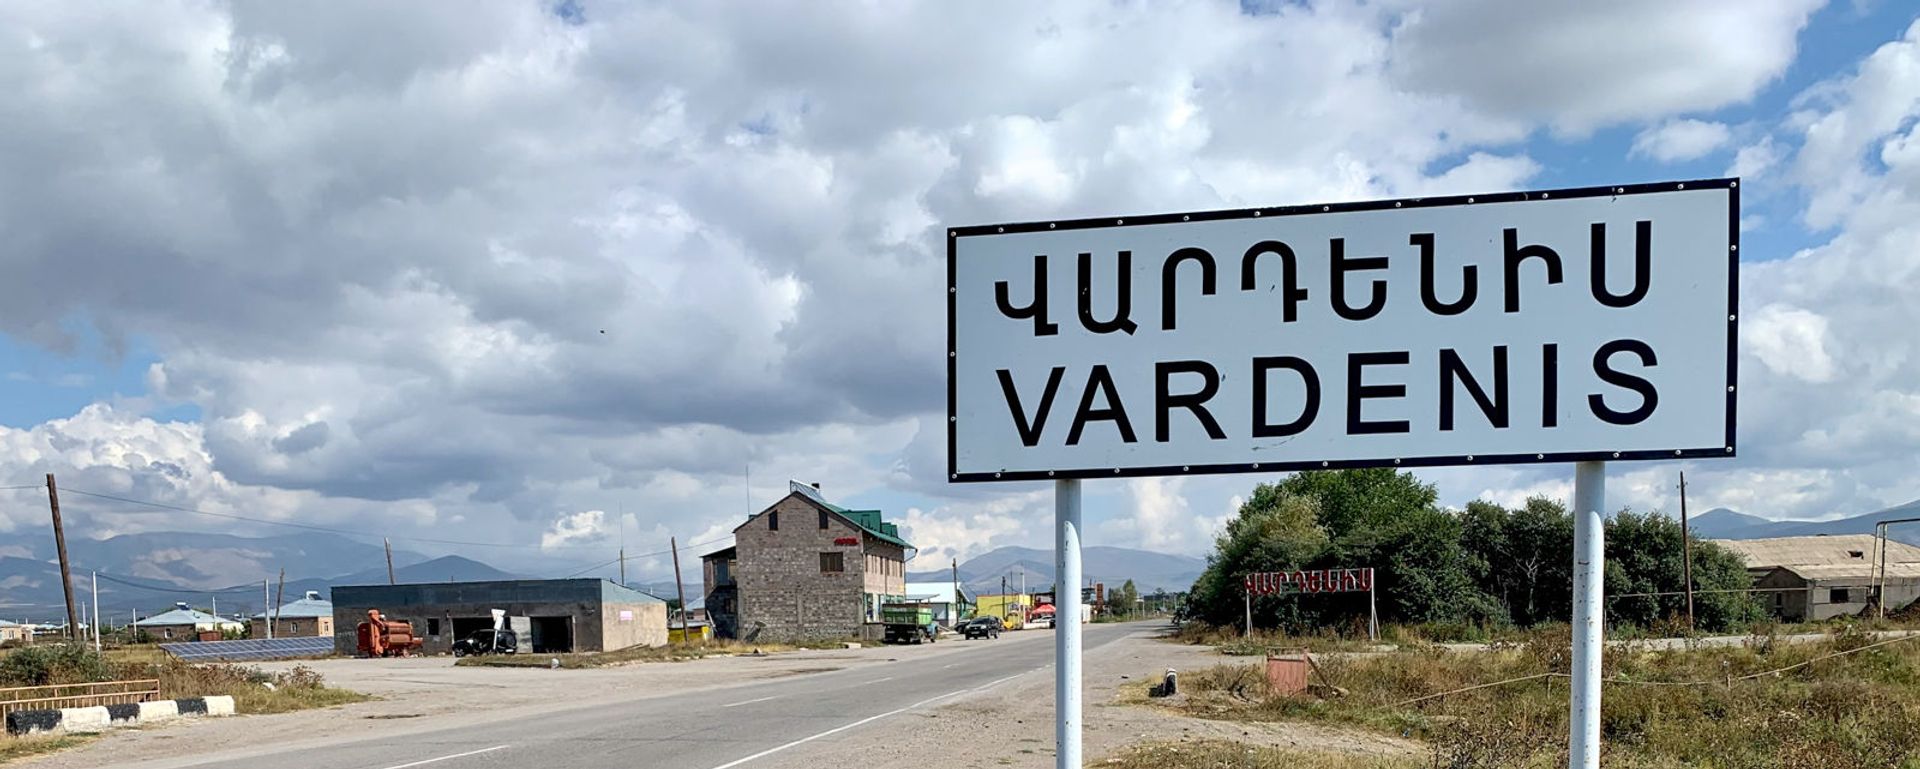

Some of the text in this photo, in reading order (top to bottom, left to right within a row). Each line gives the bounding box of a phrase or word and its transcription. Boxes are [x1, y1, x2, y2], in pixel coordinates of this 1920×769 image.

[994, 220, 1652, 337] ՎԱՐԴԵՆԻՍ
[995, 339, 1659, 447] VARDENIS
[1244, 568, 1373, 596] ՎԱՐԴԵՆԻՍ
